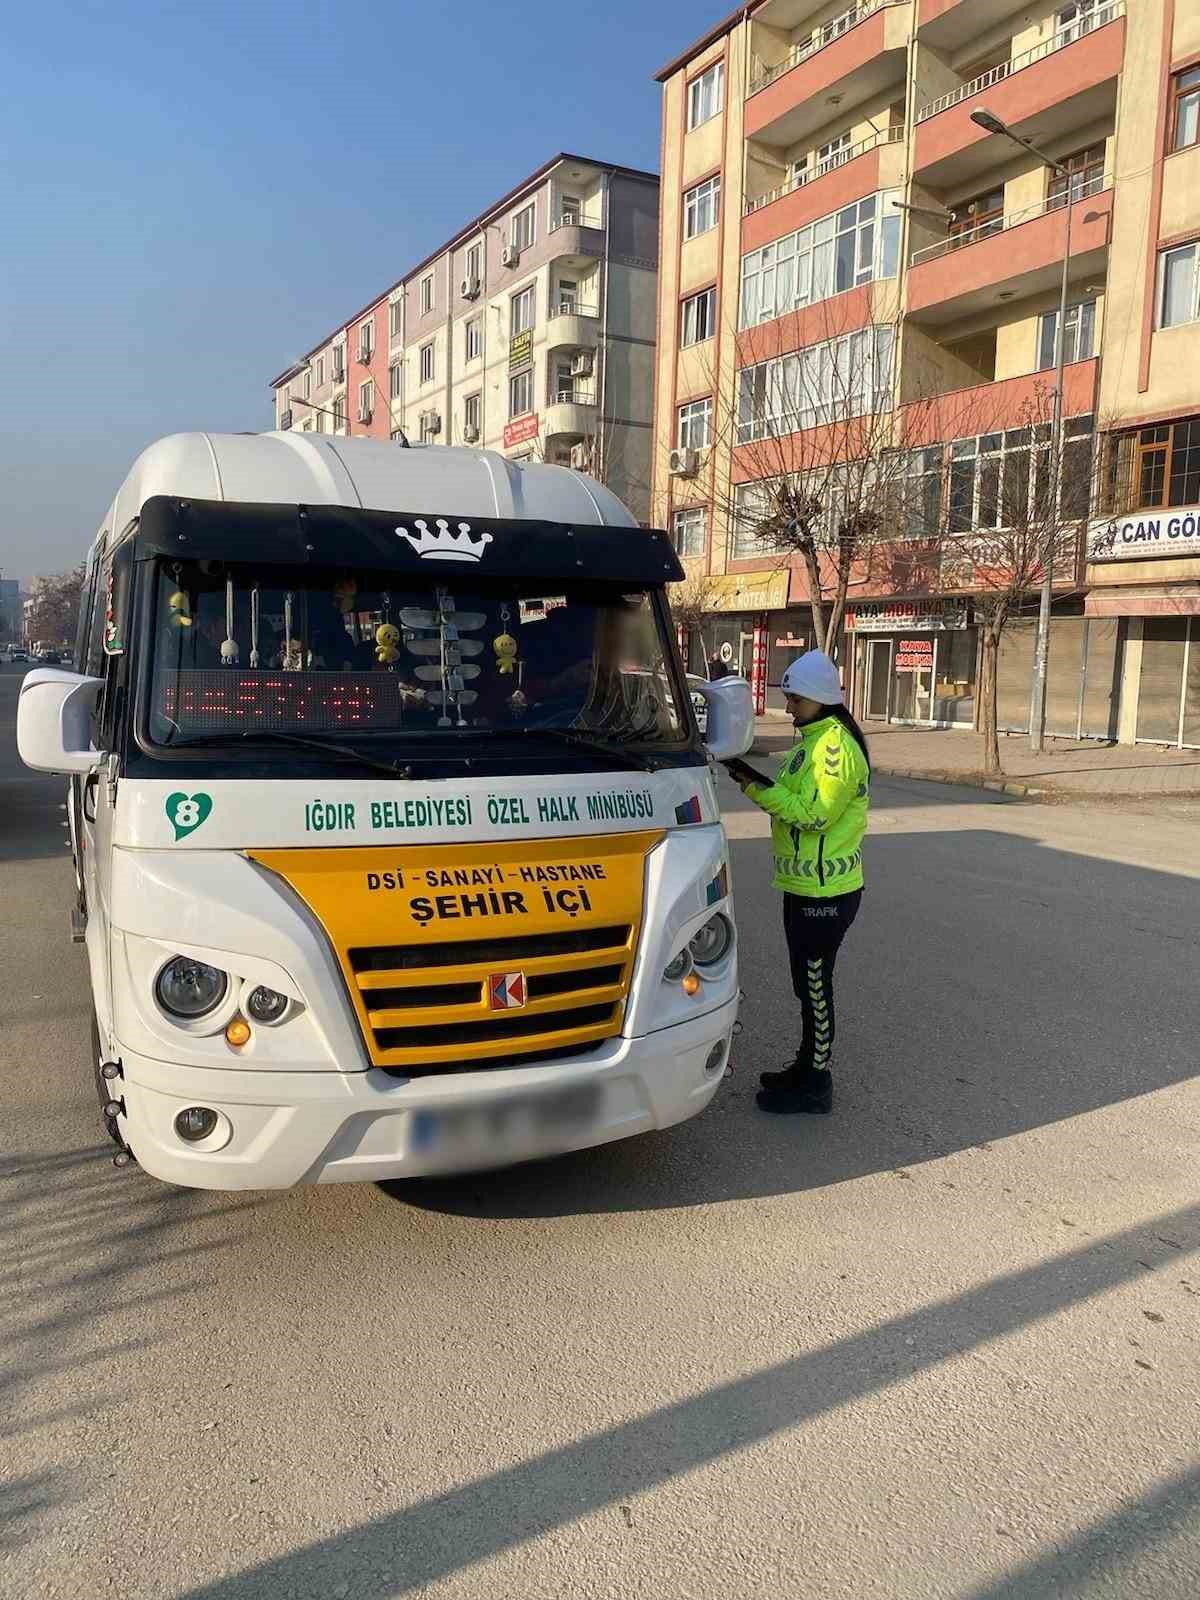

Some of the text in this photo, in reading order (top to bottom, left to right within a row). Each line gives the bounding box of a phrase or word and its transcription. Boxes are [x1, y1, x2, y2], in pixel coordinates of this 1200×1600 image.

[1122, 512, 1200, 543] CAN GÖ
[174, 799, 201, 827] 8
[304, 790, 654, 831] IĞDIR BELEDİYESİ ÖZEL HALK MİNİBÜSÜ
[367, 868, 405, 891] DSİ
[426, 863, 505, 887] SANAYİ
[519, 864, 607, 883] HASTANE
[409, 885, 592, 927] ŞEHİR İÇİ
